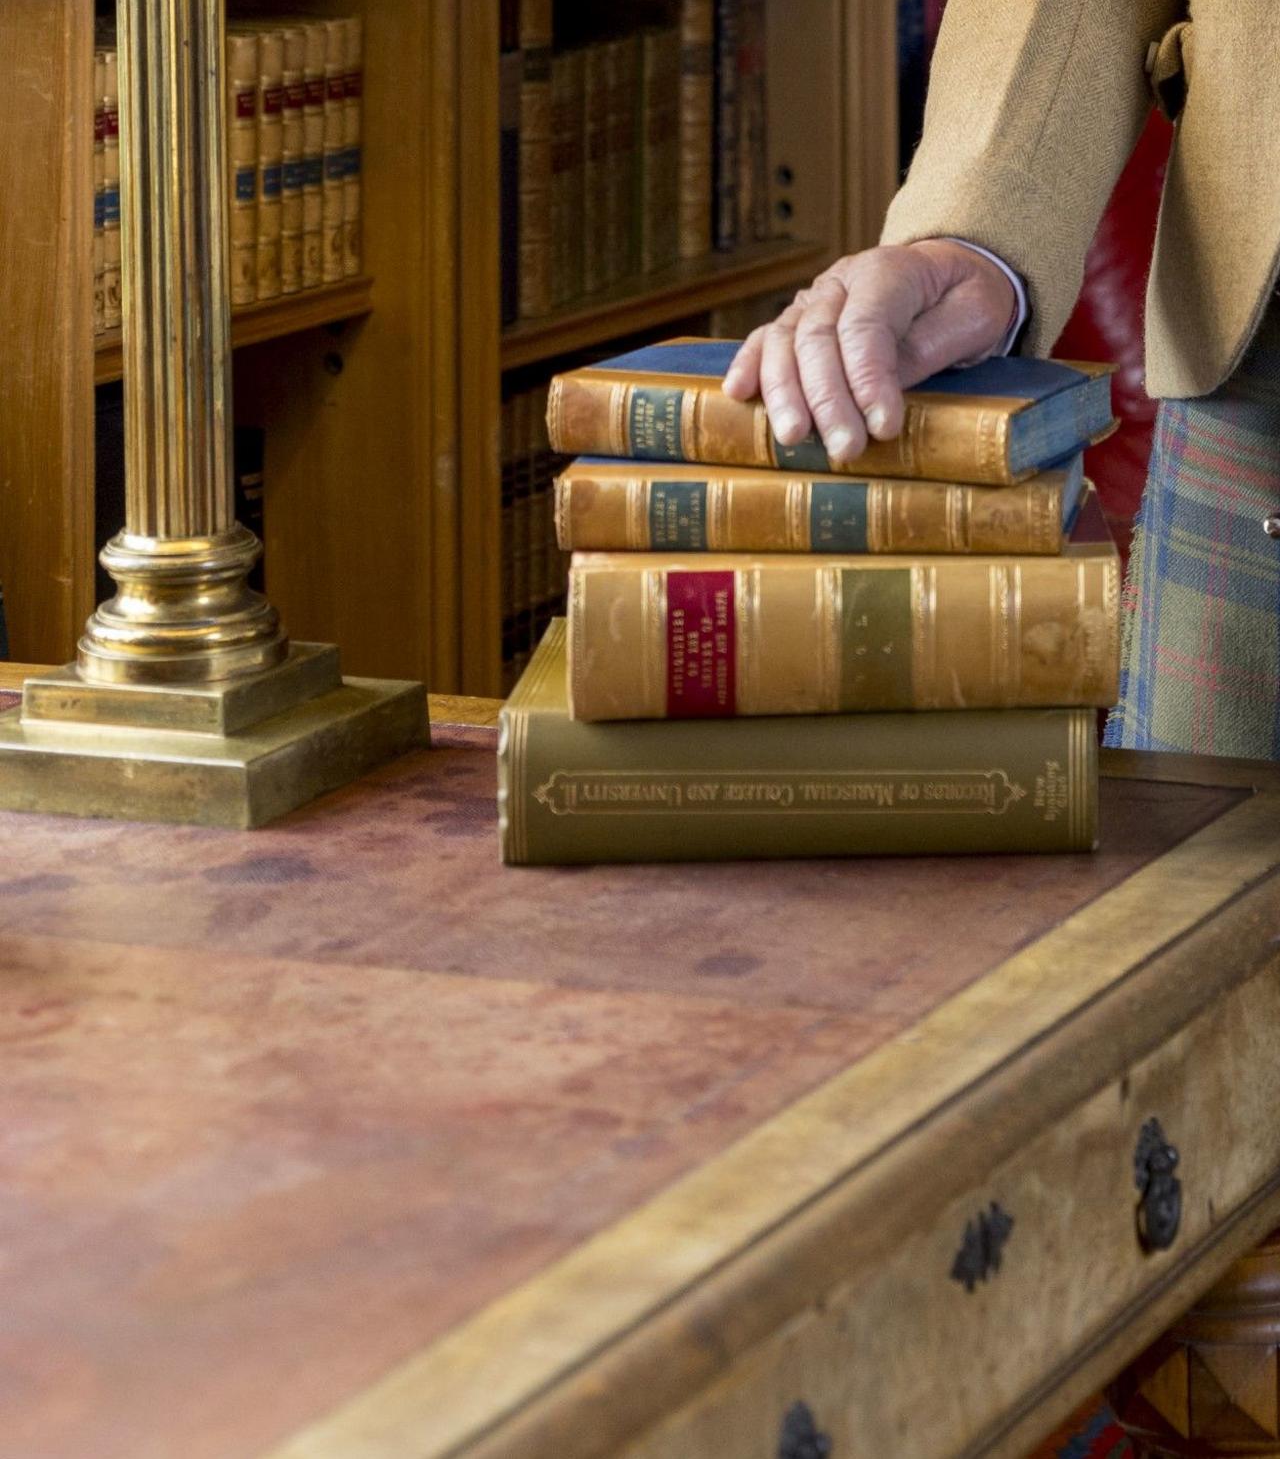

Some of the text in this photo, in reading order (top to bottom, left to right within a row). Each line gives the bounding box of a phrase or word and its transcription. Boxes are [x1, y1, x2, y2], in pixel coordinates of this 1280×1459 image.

[665, 397, 676, 456] SCOTLAND
[672, 608, 685, 695] ANTIQUITIES
[687, 630, 699, 654] THE
[716, 632, 727, 654] AND
